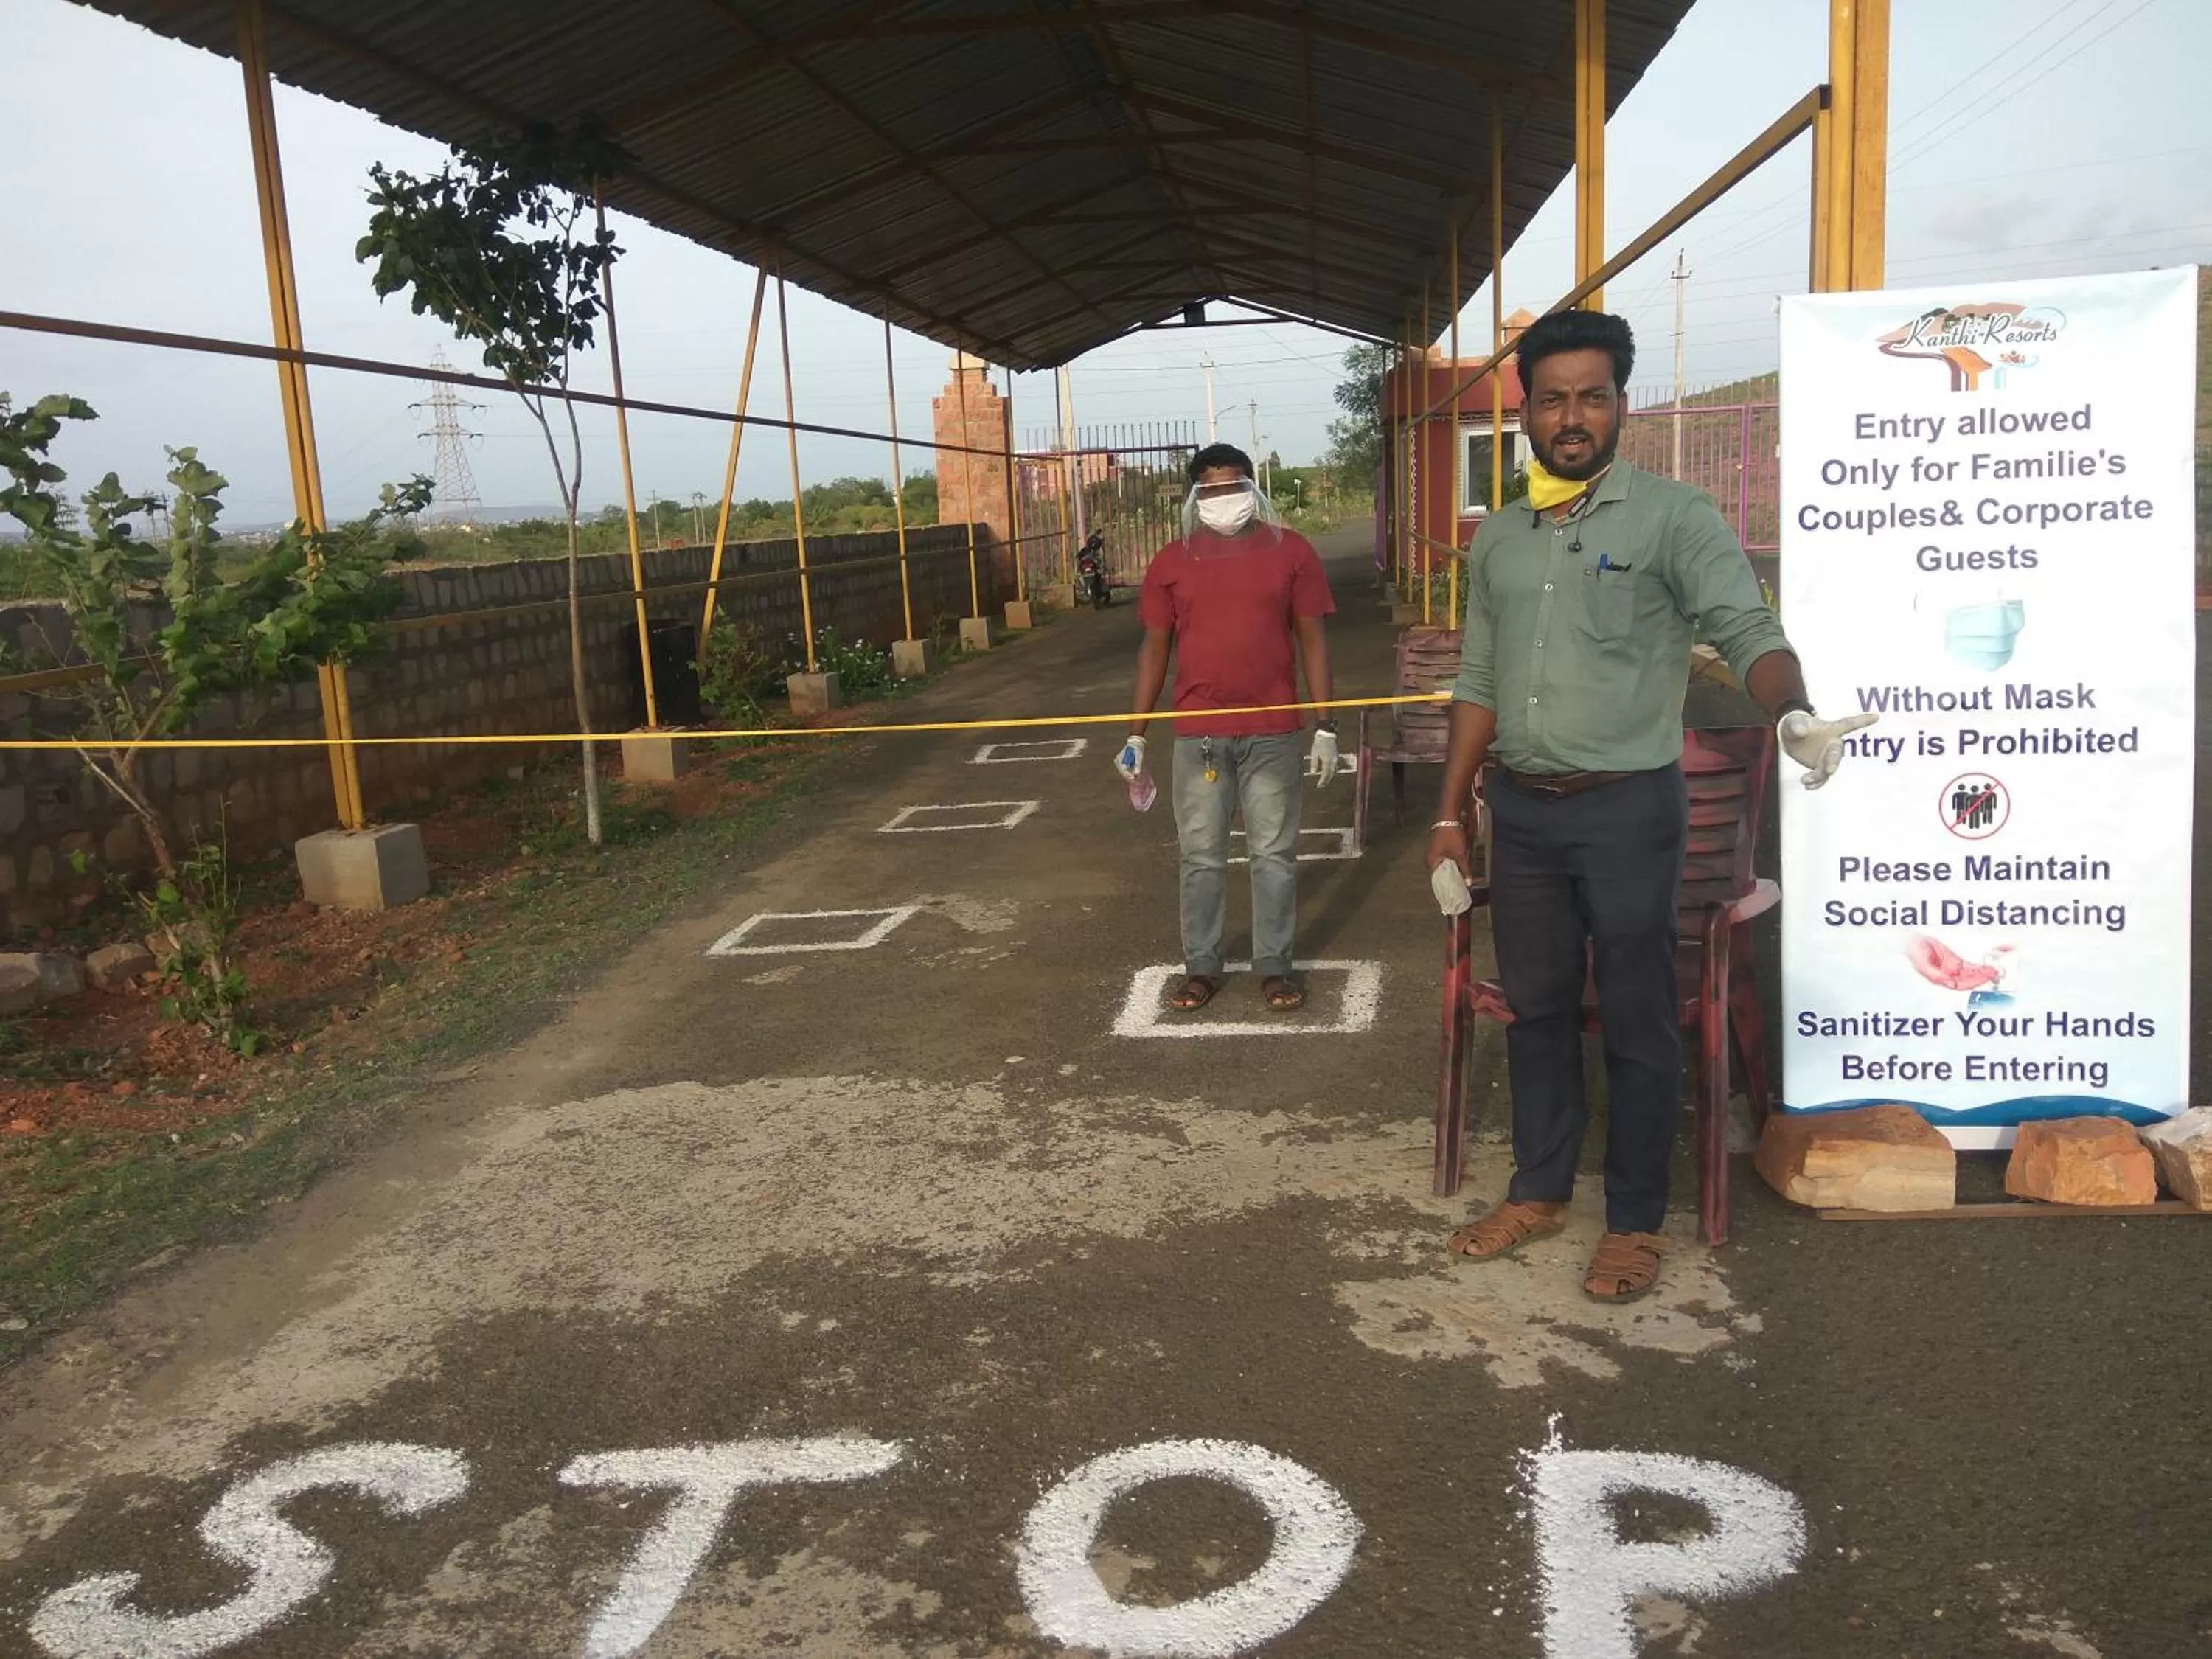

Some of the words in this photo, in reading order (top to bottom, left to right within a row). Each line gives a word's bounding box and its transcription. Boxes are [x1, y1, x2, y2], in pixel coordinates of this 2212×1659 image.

[1855, 411, 1946, 444] Entry
[1958, 403, 2092, 436] allowed
[1821, 458, 1900, 490] Only
[1911, 456, 1960, 482] for
[1972, 448, 2126, 480] Familie's
[1798, 498, 1964, 536] Couples&
[1977, 495, 2154, 529] Corporate
[1916, 544, 2039, 572] Guests
[1856, 686, 1993, 713] Without
[2005, 682, 2096, 710] Mask
[1841, 731, 1905, 764] ntry
[1918, 730, 1945, 756] is
[1958, 726, 2139, 756] Prohibited
[1839, 856, 1952, 882] Please
[1964, 855, 2111, 881] Maintain
[1824, 900, 1927, 927] Social
[1941, 899, 2126, 932] Distancing
[1797, 1010, 1945, 1039] Sanitizer
[1955, 1011, 2034, 1038] Your
[2046, 1011, 2156, 1038] Hands
[1842, 1054, 1952, 1082] Before
[1965, 1054, 2109, 1088] Entering
[29, 1438, 1808, 1659] STOP
